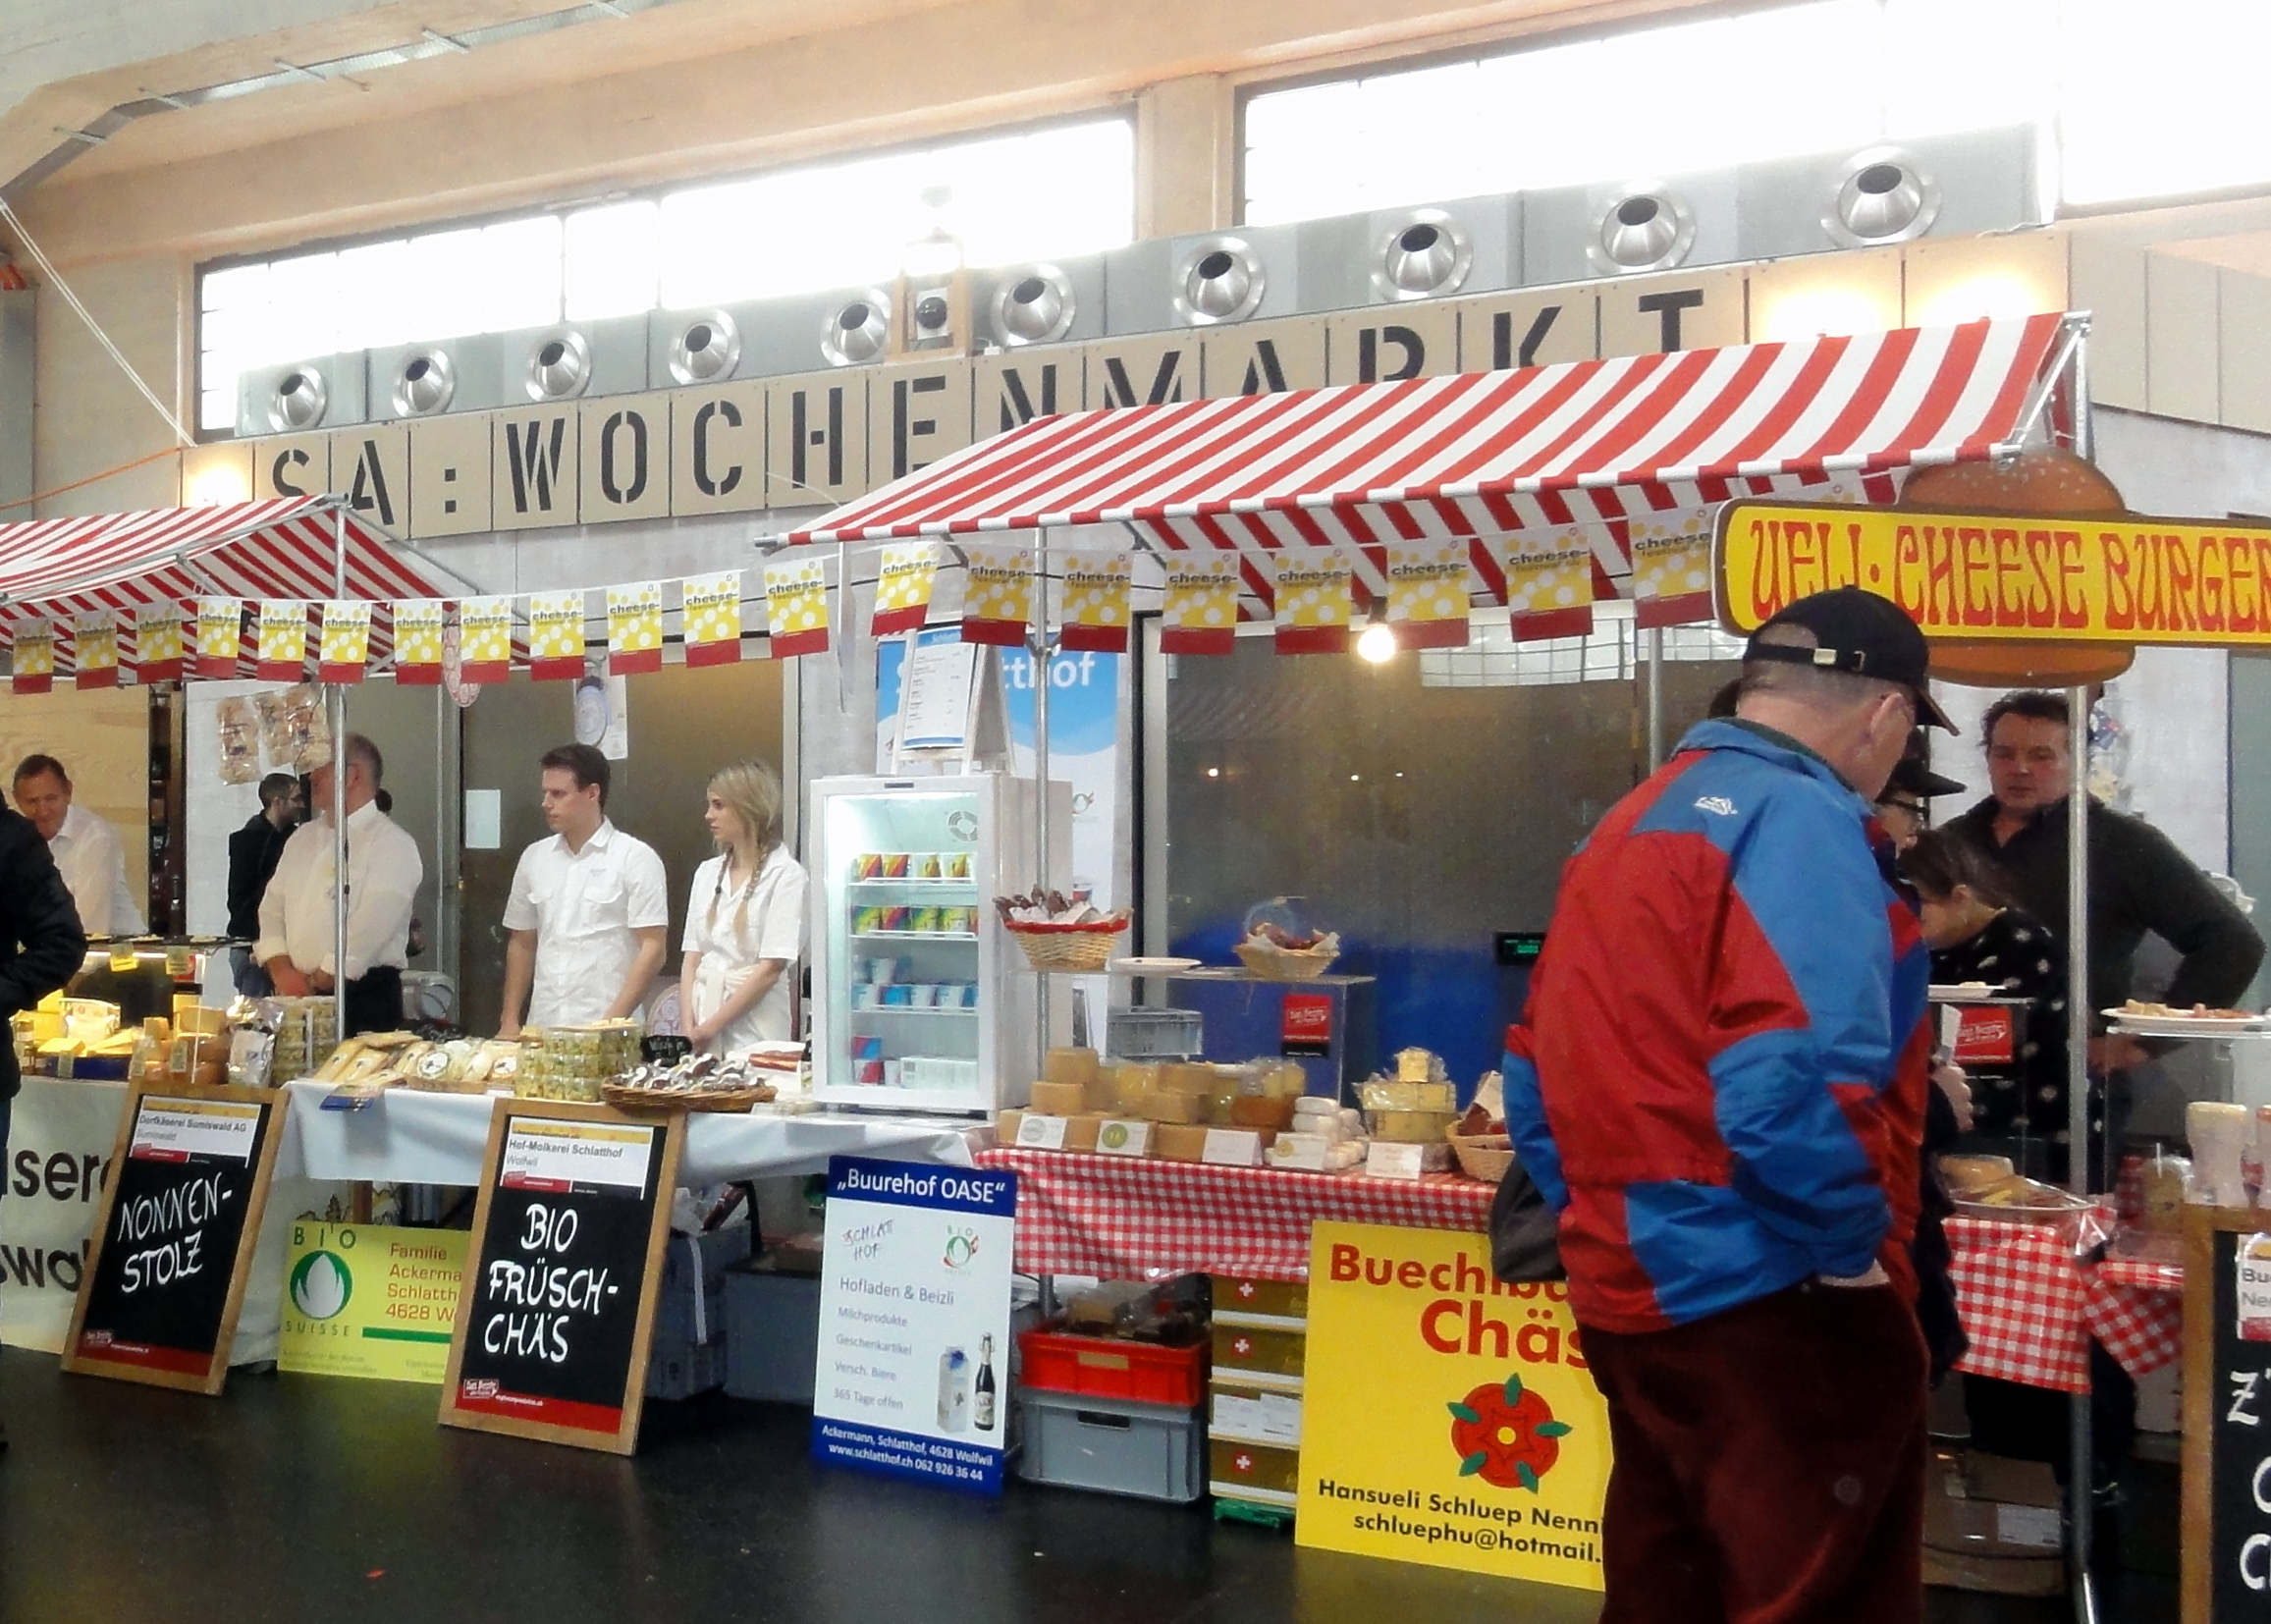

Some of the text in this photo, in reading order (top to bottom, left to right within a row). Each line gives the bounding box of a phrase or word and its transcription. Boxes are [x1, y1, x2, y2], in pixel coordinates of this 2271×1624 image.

[1894, 525, 2089, 629] CHEESE
[571, 1144, 623, 1159] Schlatthof
[294, 1226, 356, 1249] BIO
[520, 1203, 579, 1253] BIO
[121, 1229, 203, 1293] STOLZ
[390, 1242, 448, 1261] Familie
[489, 1257, 620, 1316] FRÜSCH-
[839, 1276, 954, 1306] Hofladen & Beizli
[386, 1303, 431, 1321] 4628
[838, 1306, 908, 1327] Milchprodukte
[285, 1321, 351, 1337] SUISSE
[484, 1312, 569, 1364] CHÄS
[929, 1444, 954, 1460] 4628
[915, 1457, 933, 1473] 062
[1318, 1479, 1421, 1510] Hansueli
[1429, 1492, 1523, 1528] Schluep
